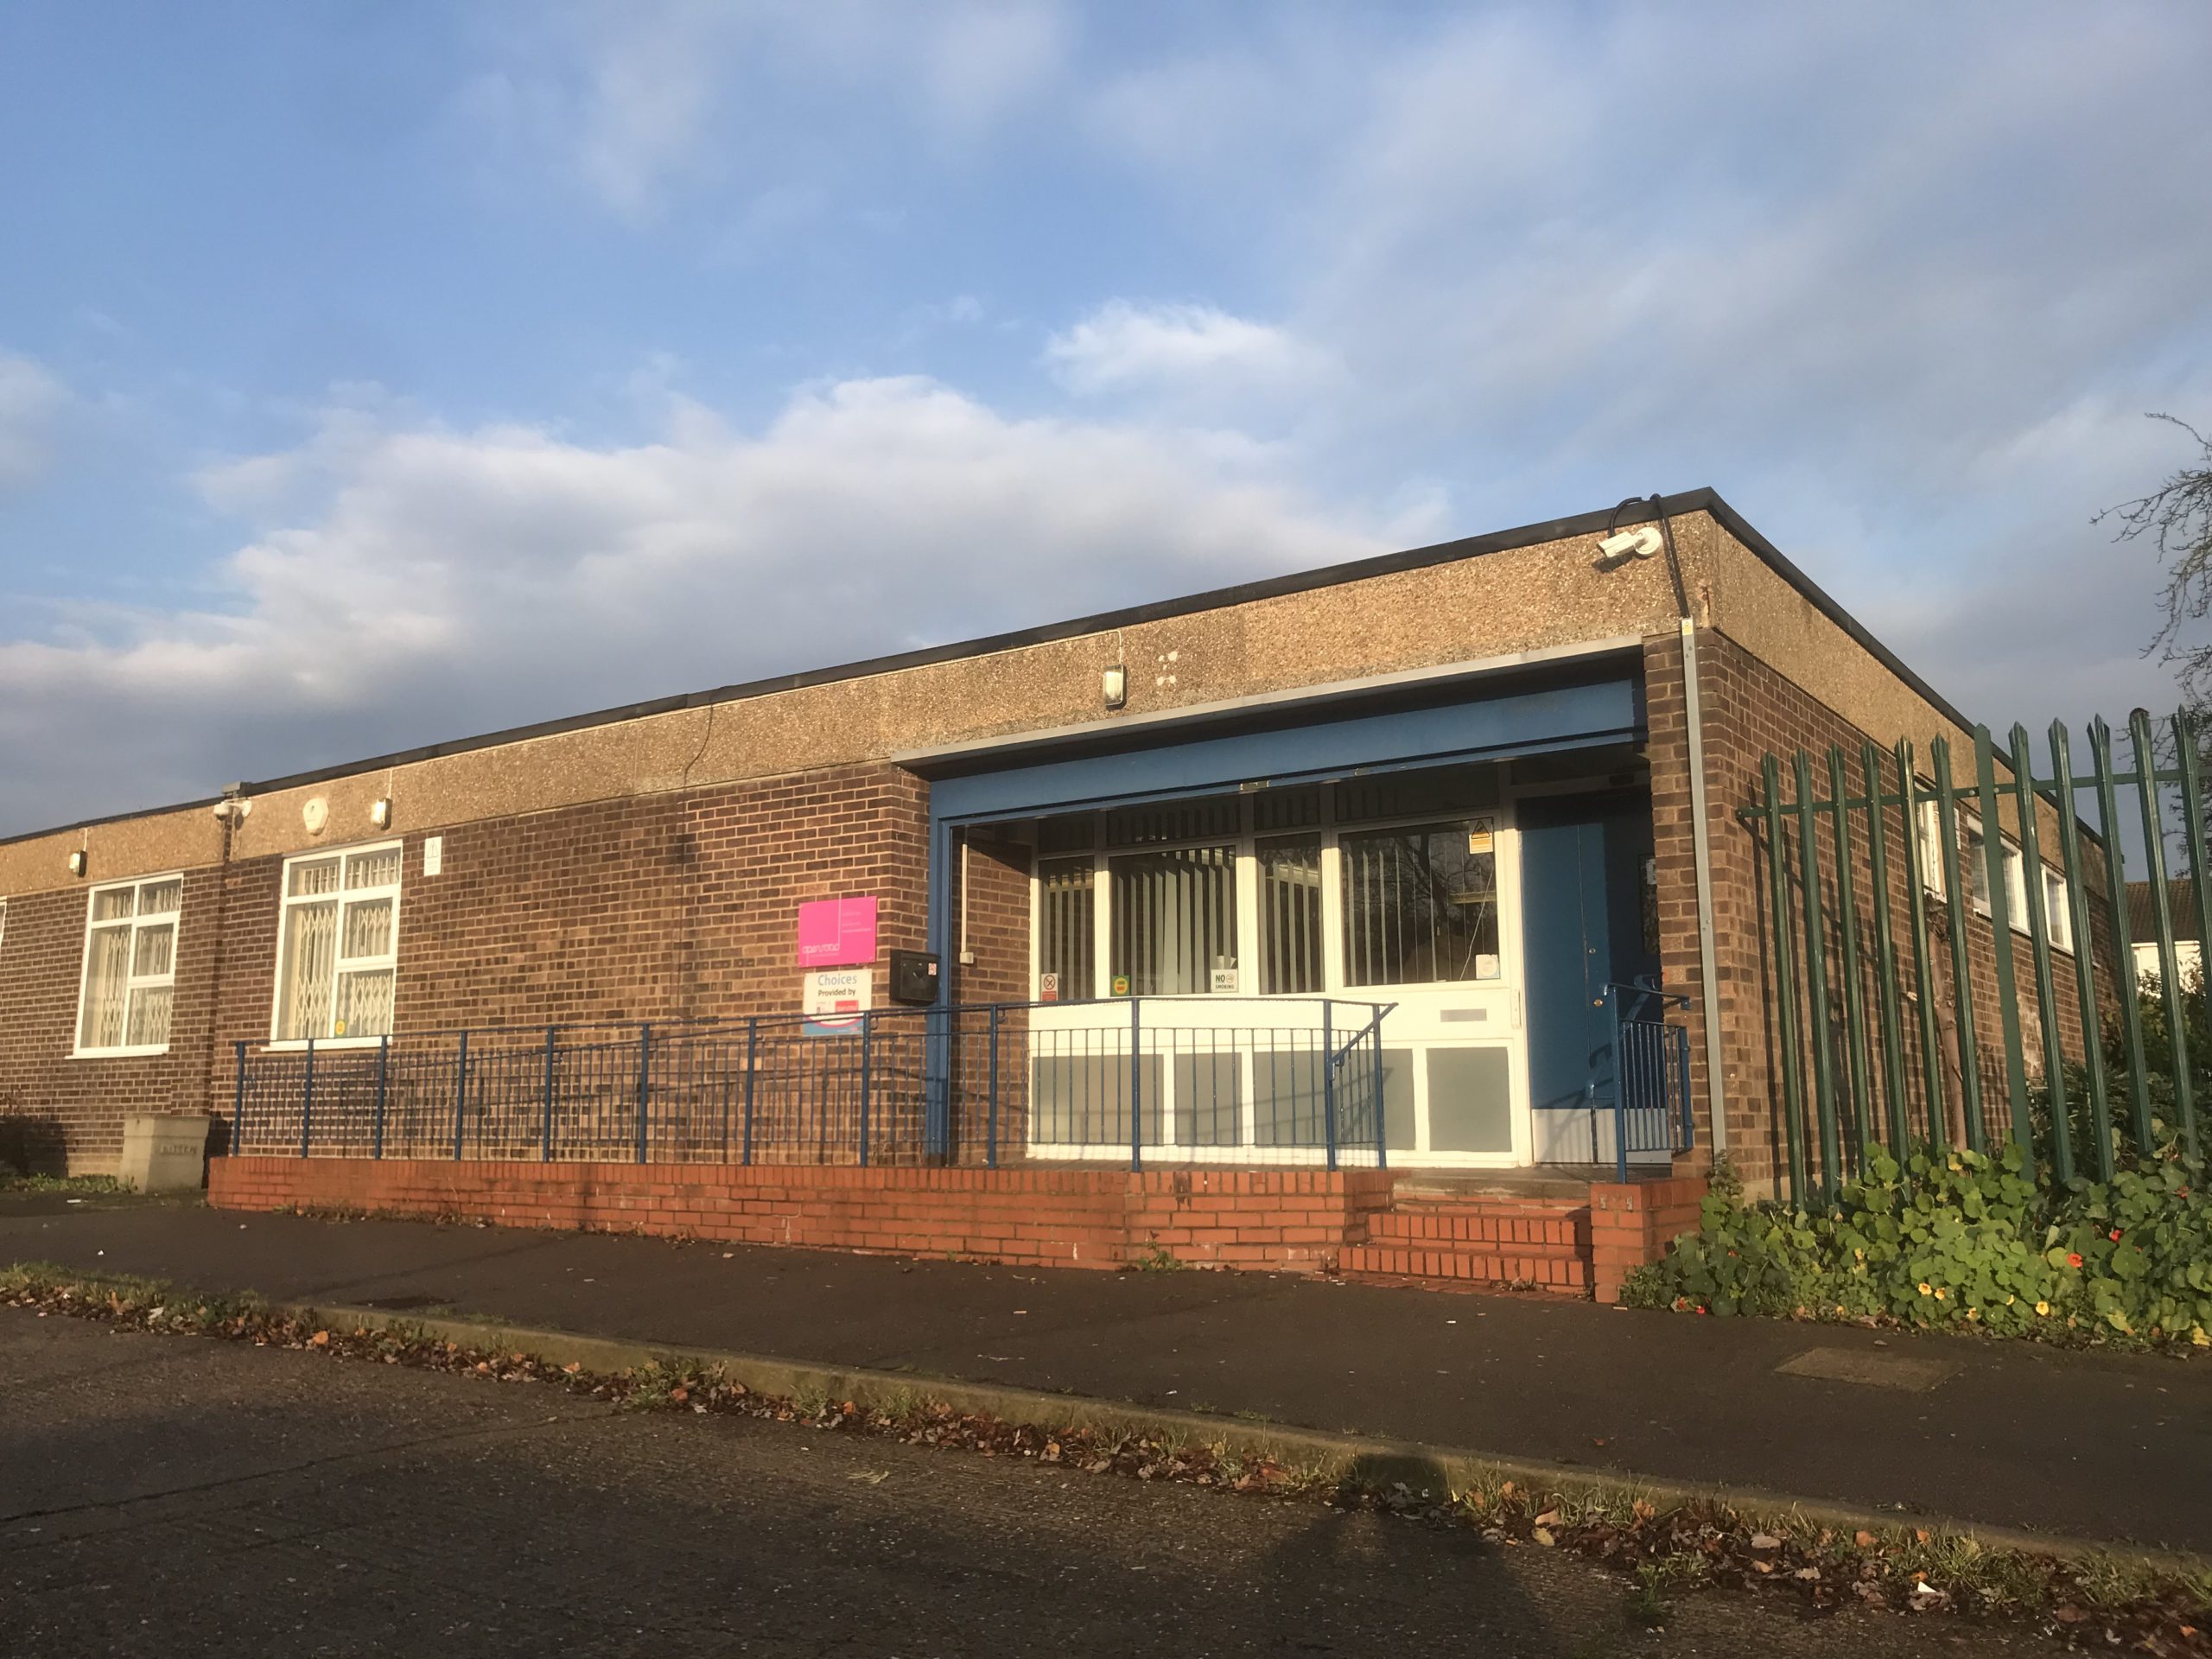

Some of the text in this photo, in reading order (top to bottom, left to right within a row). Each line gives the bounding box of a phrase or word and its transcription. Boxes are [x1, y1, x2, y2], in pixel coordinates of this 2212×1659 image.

[817, 973, 857, 986] Choices
[1216, 974, 1226, 982] NO
[848, 988, 856, 996] by
